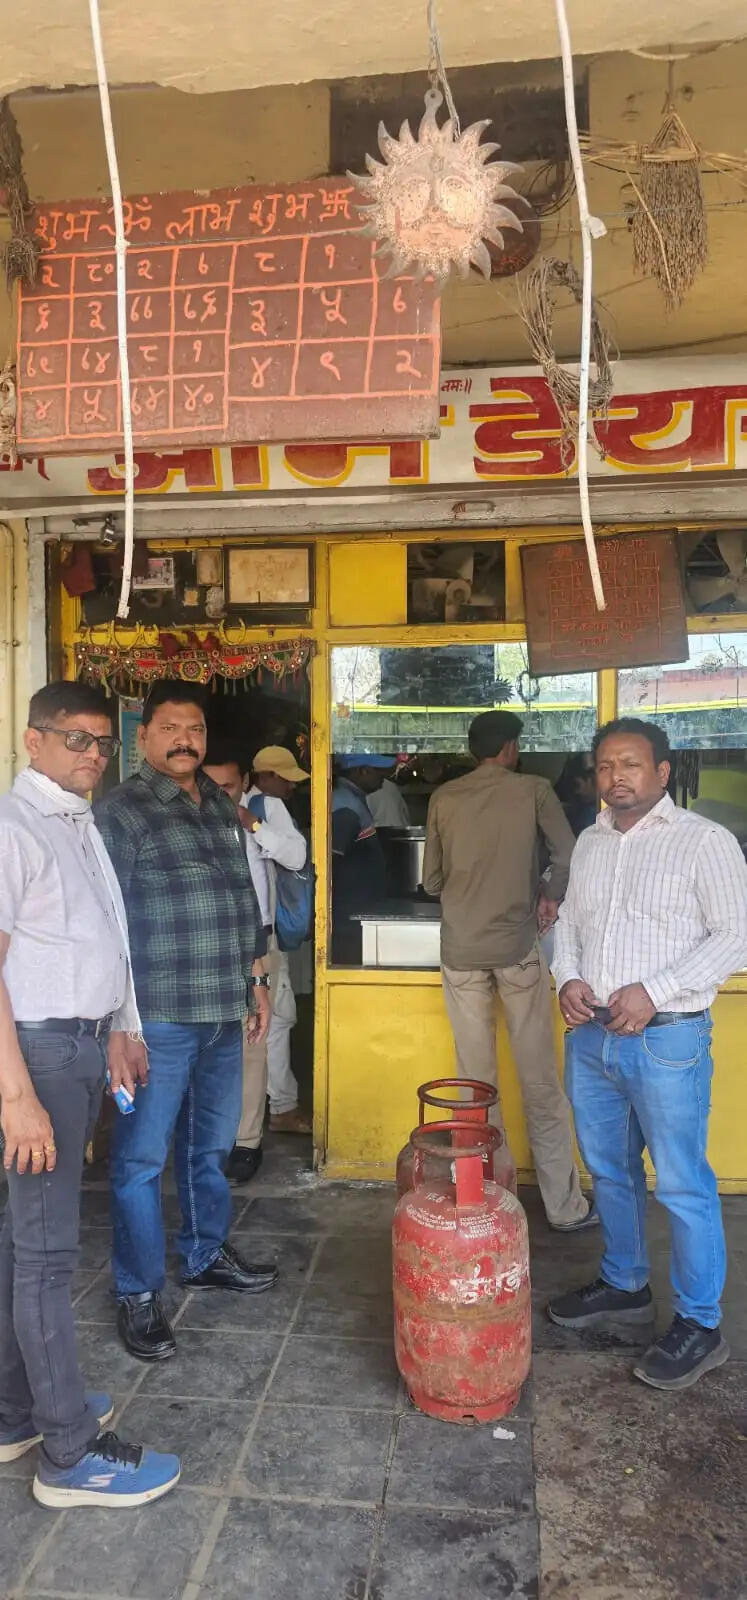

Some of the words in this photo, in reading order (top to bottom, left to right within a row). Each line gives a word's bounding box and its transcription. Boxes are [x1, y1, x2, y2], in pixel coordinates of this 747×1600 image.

[35, 209, 99, 250] शुभ
[166, 199, 241, 240] लाभ
[249, 192, 315, 234] शुभ
[87, 263, 114, 281] ८०
[137, 259, 153, 280] २
[255, 253, 276, 272] ८
[324, 244, 336, 269] १
[35, 303, 51, 333] ६
[87, 301, 107, 331] ३
[130, 295, 152, 322] ७७
[249, 300, 268, 336] ३
[320, 287, 347, 325] ५
[81, 346, 112, 374] ७४
[139, 345, 158, 362] ८
[193, 339, 203, 363] १
[251, 357, 272, 389] ४
[395, 350, 422, 378] २
[35, 399, 54, 421] ४
[83, 389, 108, 423] ५
[183, 384, 214, 412] ४०
[468, 376, 747, 482] डेय
